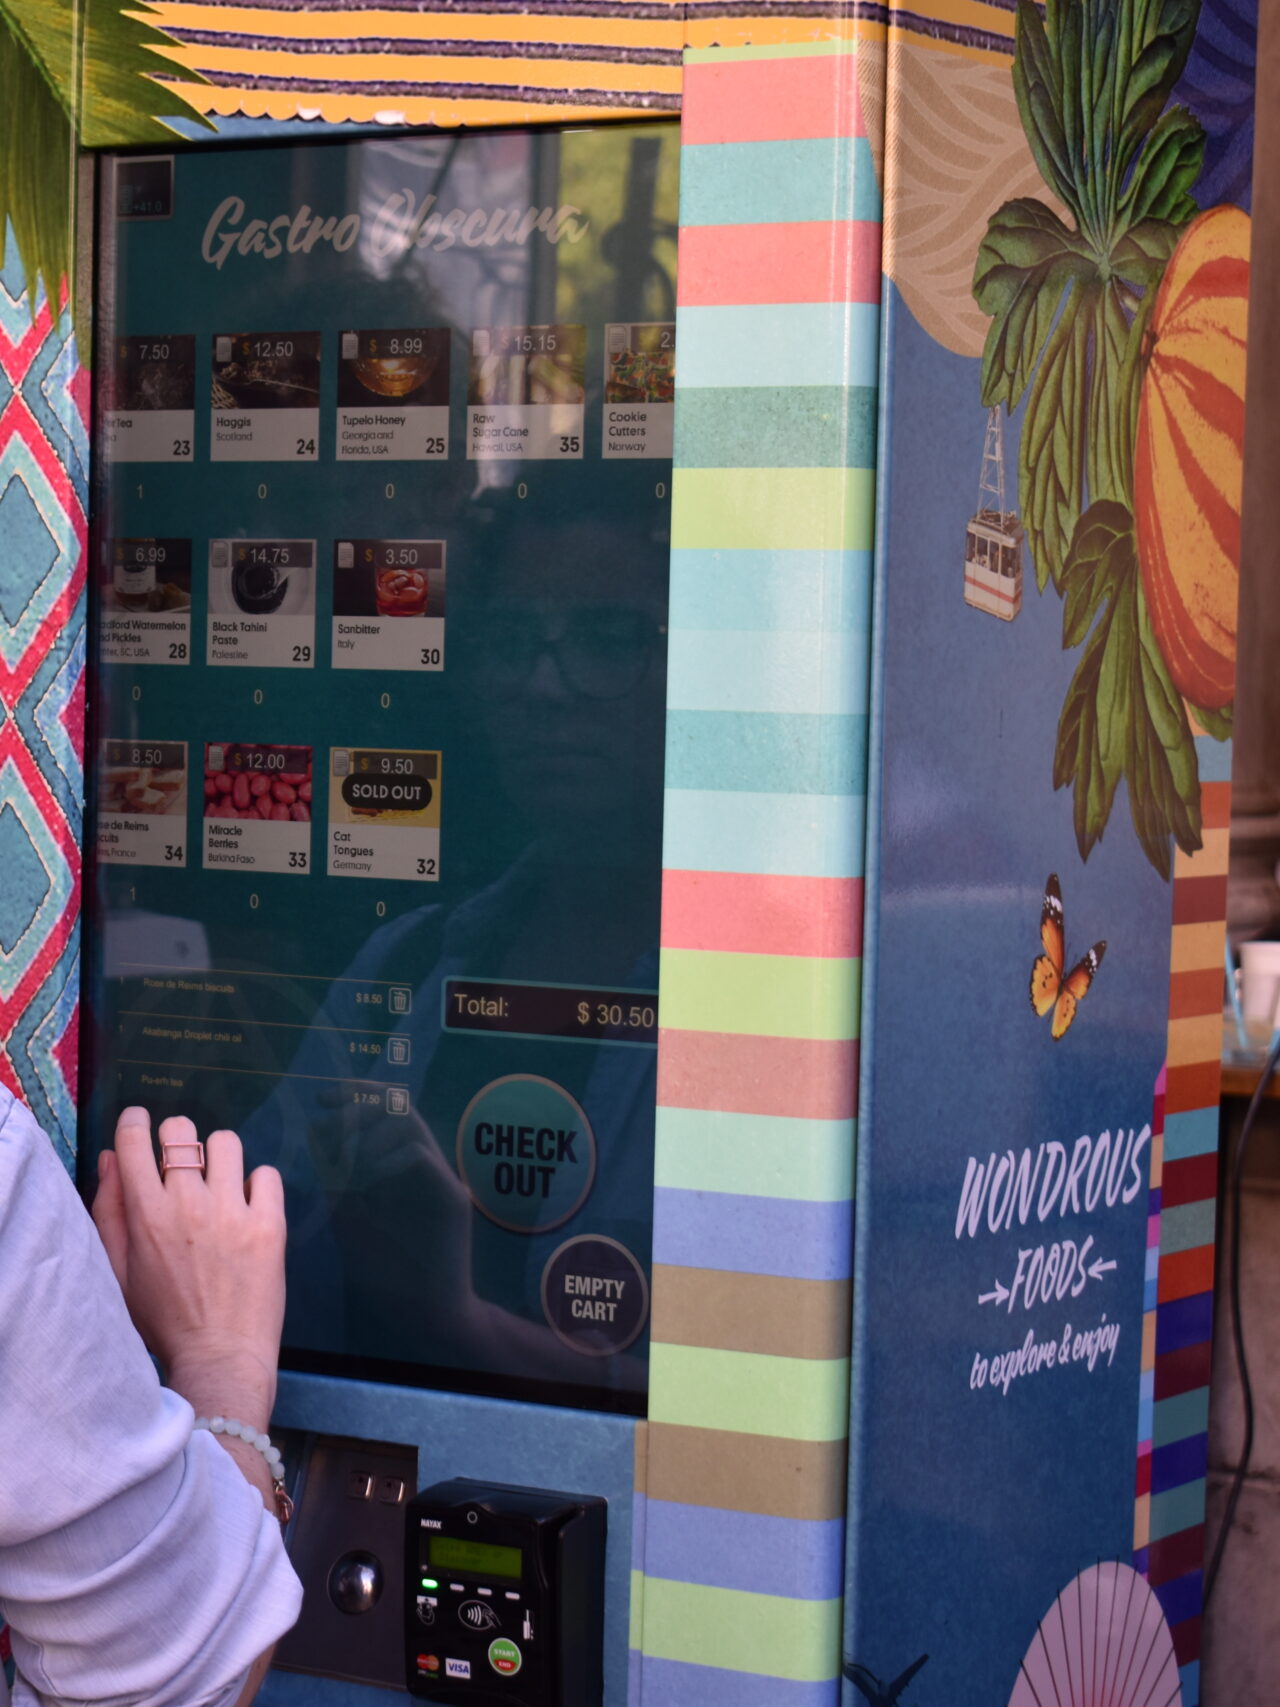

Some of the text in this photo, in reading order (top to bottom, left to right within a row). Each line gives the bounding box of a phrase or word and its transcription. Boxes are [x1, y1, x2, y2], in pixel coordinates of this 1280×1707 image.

[201, 187, 590, 270] Gastro Obscura
[255, 341, 294, 358] 12.50
[390, 338, 423, 354] 8.99
[514, 335, 556, 351] 15.15
[139, 344, 170, 360] 7.50
[216, 417, 251, 430] Haggis
[342, 414, 406, 427] Tupelo Honey
[473, 413, 495, 424] Raw
[609, 411, 647, 423] Cookie
[216, 431, 253, 442] Scotland
[342, 429, 394, 442] Georgia and
[473, 426, 529, 439] Sugar Cane
[609, 426, 646, 437] Cutters
[172, 440, 191, 456] 23
[296, 439, 316, 455] 24
[372, 445, 389, 455] USA
[425, 437, 445, 454] 25
[506, 442, 524, 452] USA
[559, 436, 580, 453] 35
[608, 442, 646, 453] Norway
[136, 484, 144, 499] 1
[257, 484, 267, 500] 0
[385, 483, 395, 499] 0
[517, 483, 527, 499] 0
[655, 482, 665, 498] 0
[136, 547, 166, 563] 6.99
[250, 548, 289, 564] 14.75
[385, 548, 418, 565] 3.50
[99, 620, 186, 631] adford Watermelon
[212, 621, 268, 633] Black Tahini
[337, 624, 381, 635] Sanbitter
[111, 633, 141, 643] Pickles
[211, 635, 239, 647] Paste
[337, 639, 355, 650] Italy
[133, 648, 150, 657] USA
[168, 643, 187, 659] 28
[211, 649, 249, 660] Palestine
[292, 645, 311, 662] 29
[420, 648, 441, 665] 30
[132, 685, 141, 701] 0
[254, 689, 263, 705] 0
[380, 692, 390, 709] 0
[131, 748, 162, 764] 8.50
[246, 753, 286, 769] 12.00
[381, 758, 414, 775] 9.50
[352, 784, 422, 800] SOLD OUT
[111, 820, 123, 830] de
[124, 821, 149, 832] Reims
[208, 825, 243, 836] Miracle
[208, 838, 239, 849] Berries
[333, 831, 351, 842] Cat
[111, 847, 136, 858] France
[164, 845, 183, 861] 34
[208, 853, 256, 864] Burkina Faso
[333, 845, 374, 857] Tongues
[288, 852, 307, 868] 33
[332, 860, 373, 872] Germany
[416, 858, 436, 875] 32
[249, 893, 259, 909] 0
[376, 901, 386, 917] 0
[144, 977, 164, 989] Rose
[178, 980, 203, 991] Reims
[205, 982, 236, 993] biscuits
[363, 993, 383, 1004] 8.50
[454, 993, 655, 1029] Total: $ 30.50
[232, 1033, 242, 1043] oil
[358, 1043, 381, 1055] 14.50
[361, 1093, 380, 1105] 7.50
[474, 1121, 578, 1165] CHECK
[493, 1164, 556, 1200] OUT
[955, 1123, 1152, 1240] WONDROUS
[1007, 1234, 1095, 1314] FOODS
[564, 1274, 626, 1301] EMPTY
[571, 1299, 618, 1324] CART
[969, 1312, 1120, 1397] to explore & enjoy
[420, 1518, 442, 1529] NAYAX
[494, 1648, 515, 1658] START
[448, 1662, 469, 1674] VISA
